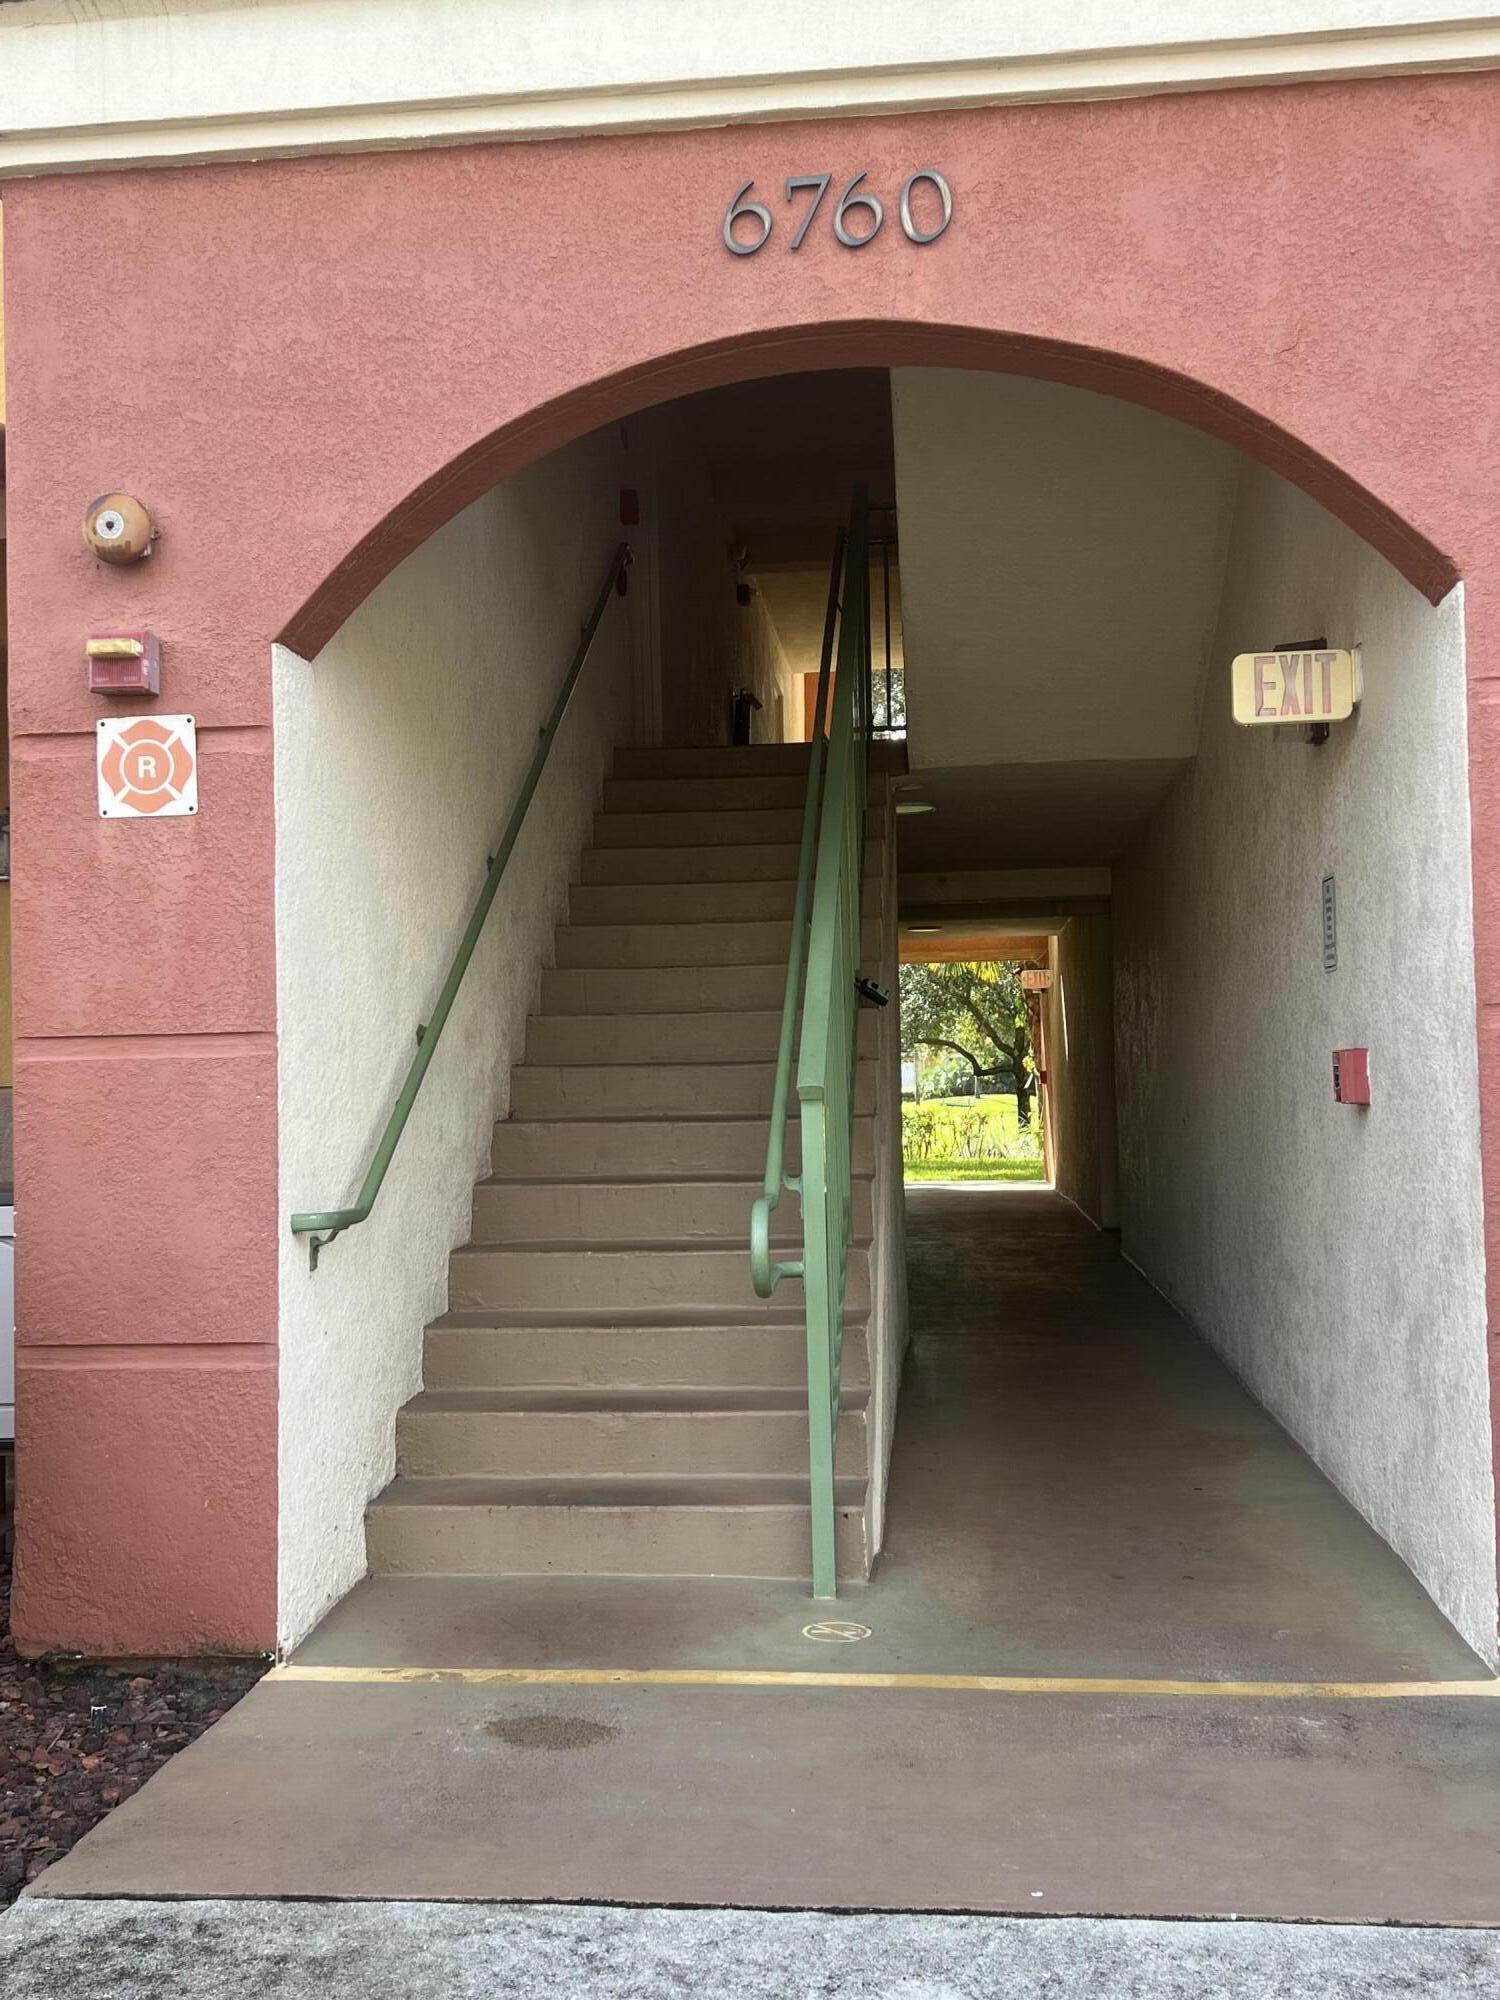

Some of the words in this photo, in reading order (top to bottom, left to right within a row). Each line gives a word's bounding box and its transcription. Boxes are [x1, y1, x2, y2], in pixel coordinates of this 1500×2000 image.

[723, 169, 952, 256] 6760
[1254, 653, 1336, 717] EXIT
[138, 755, 157, 778] R
